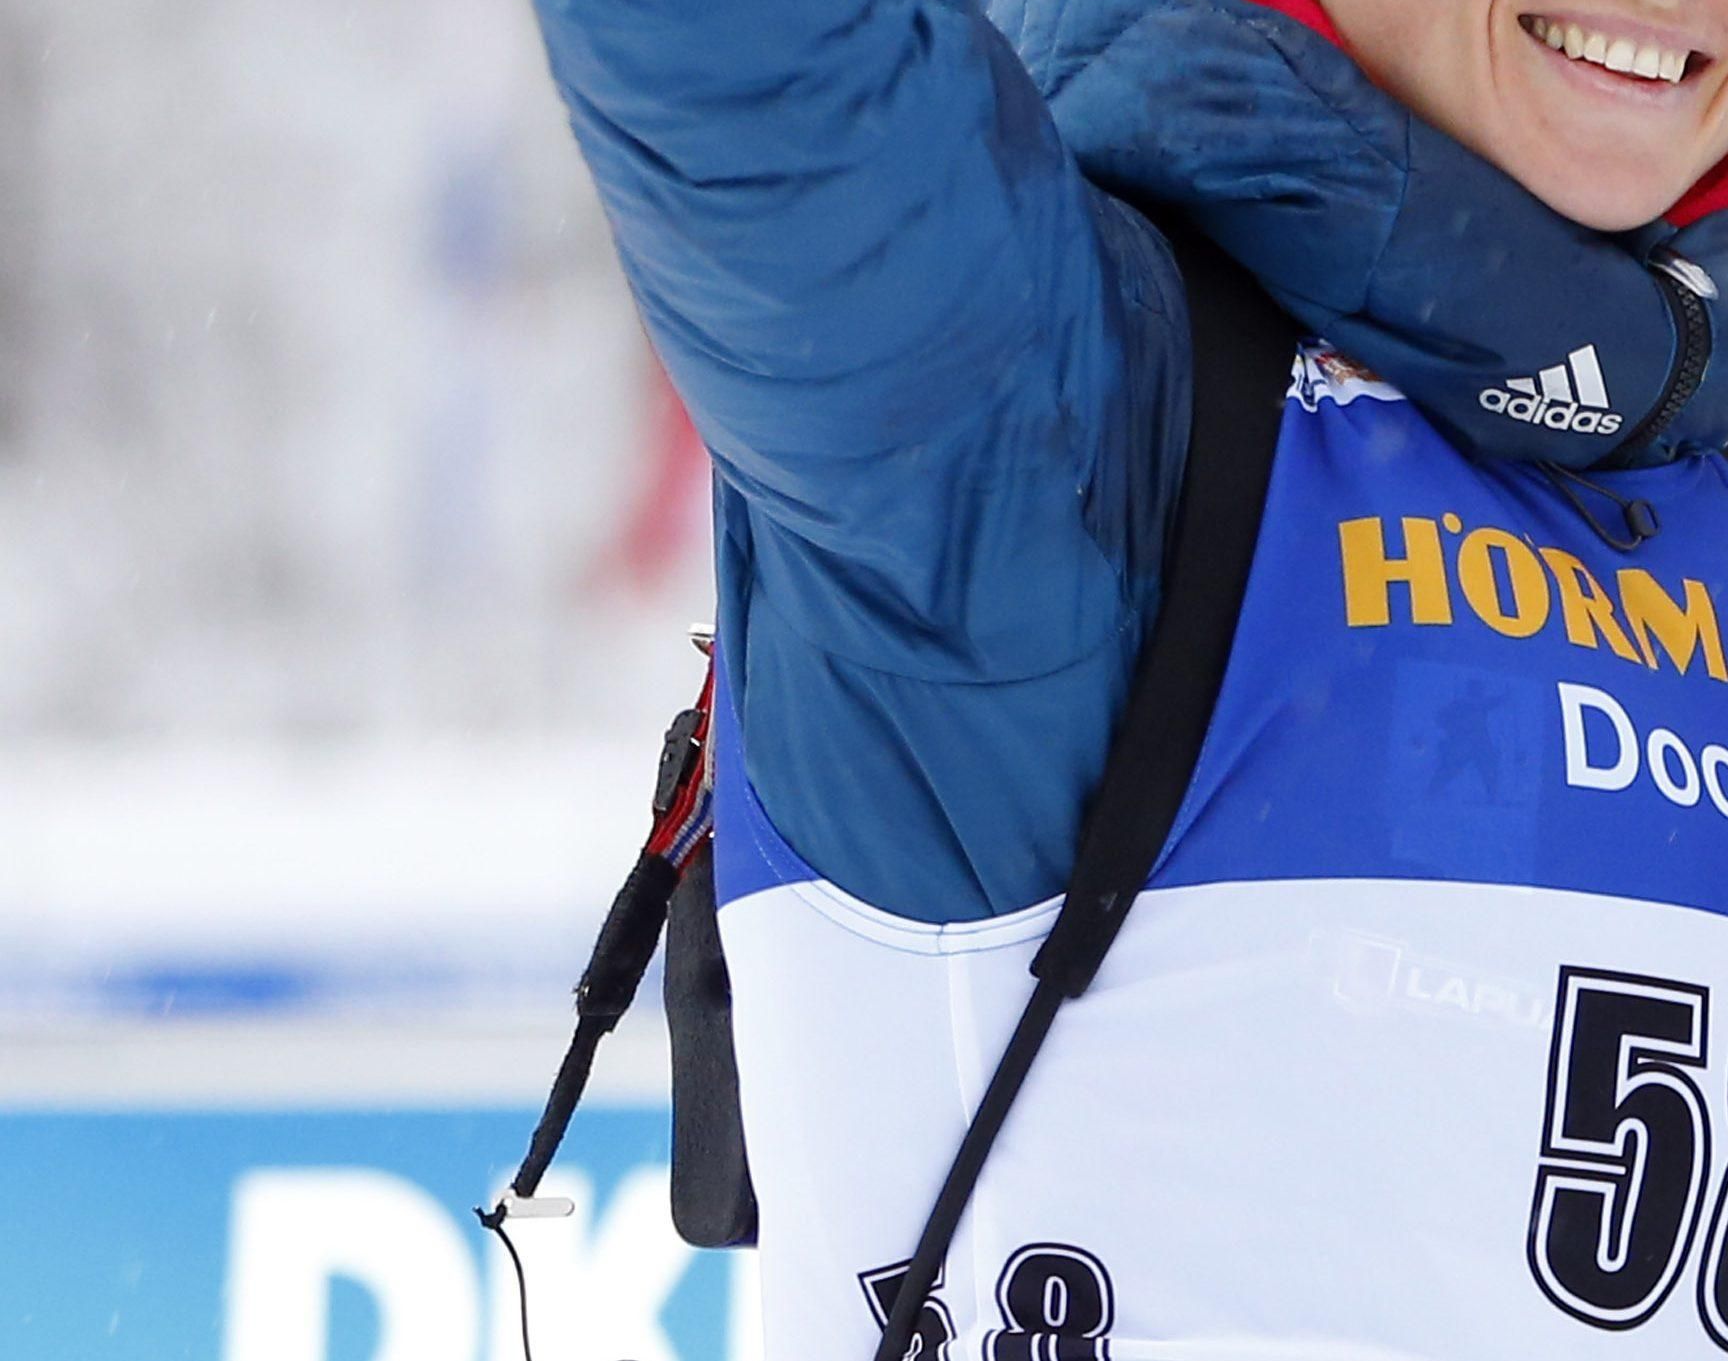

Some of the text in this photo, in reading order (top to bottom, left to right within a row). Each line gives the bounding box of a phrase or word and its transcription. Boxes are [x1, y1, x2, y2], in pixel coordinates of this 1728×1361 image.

[1479, 386, 1622, 435] adidas
[1405, 966, 1557, 1031] LAPU
[223, 1166, 762, 1361] DK
